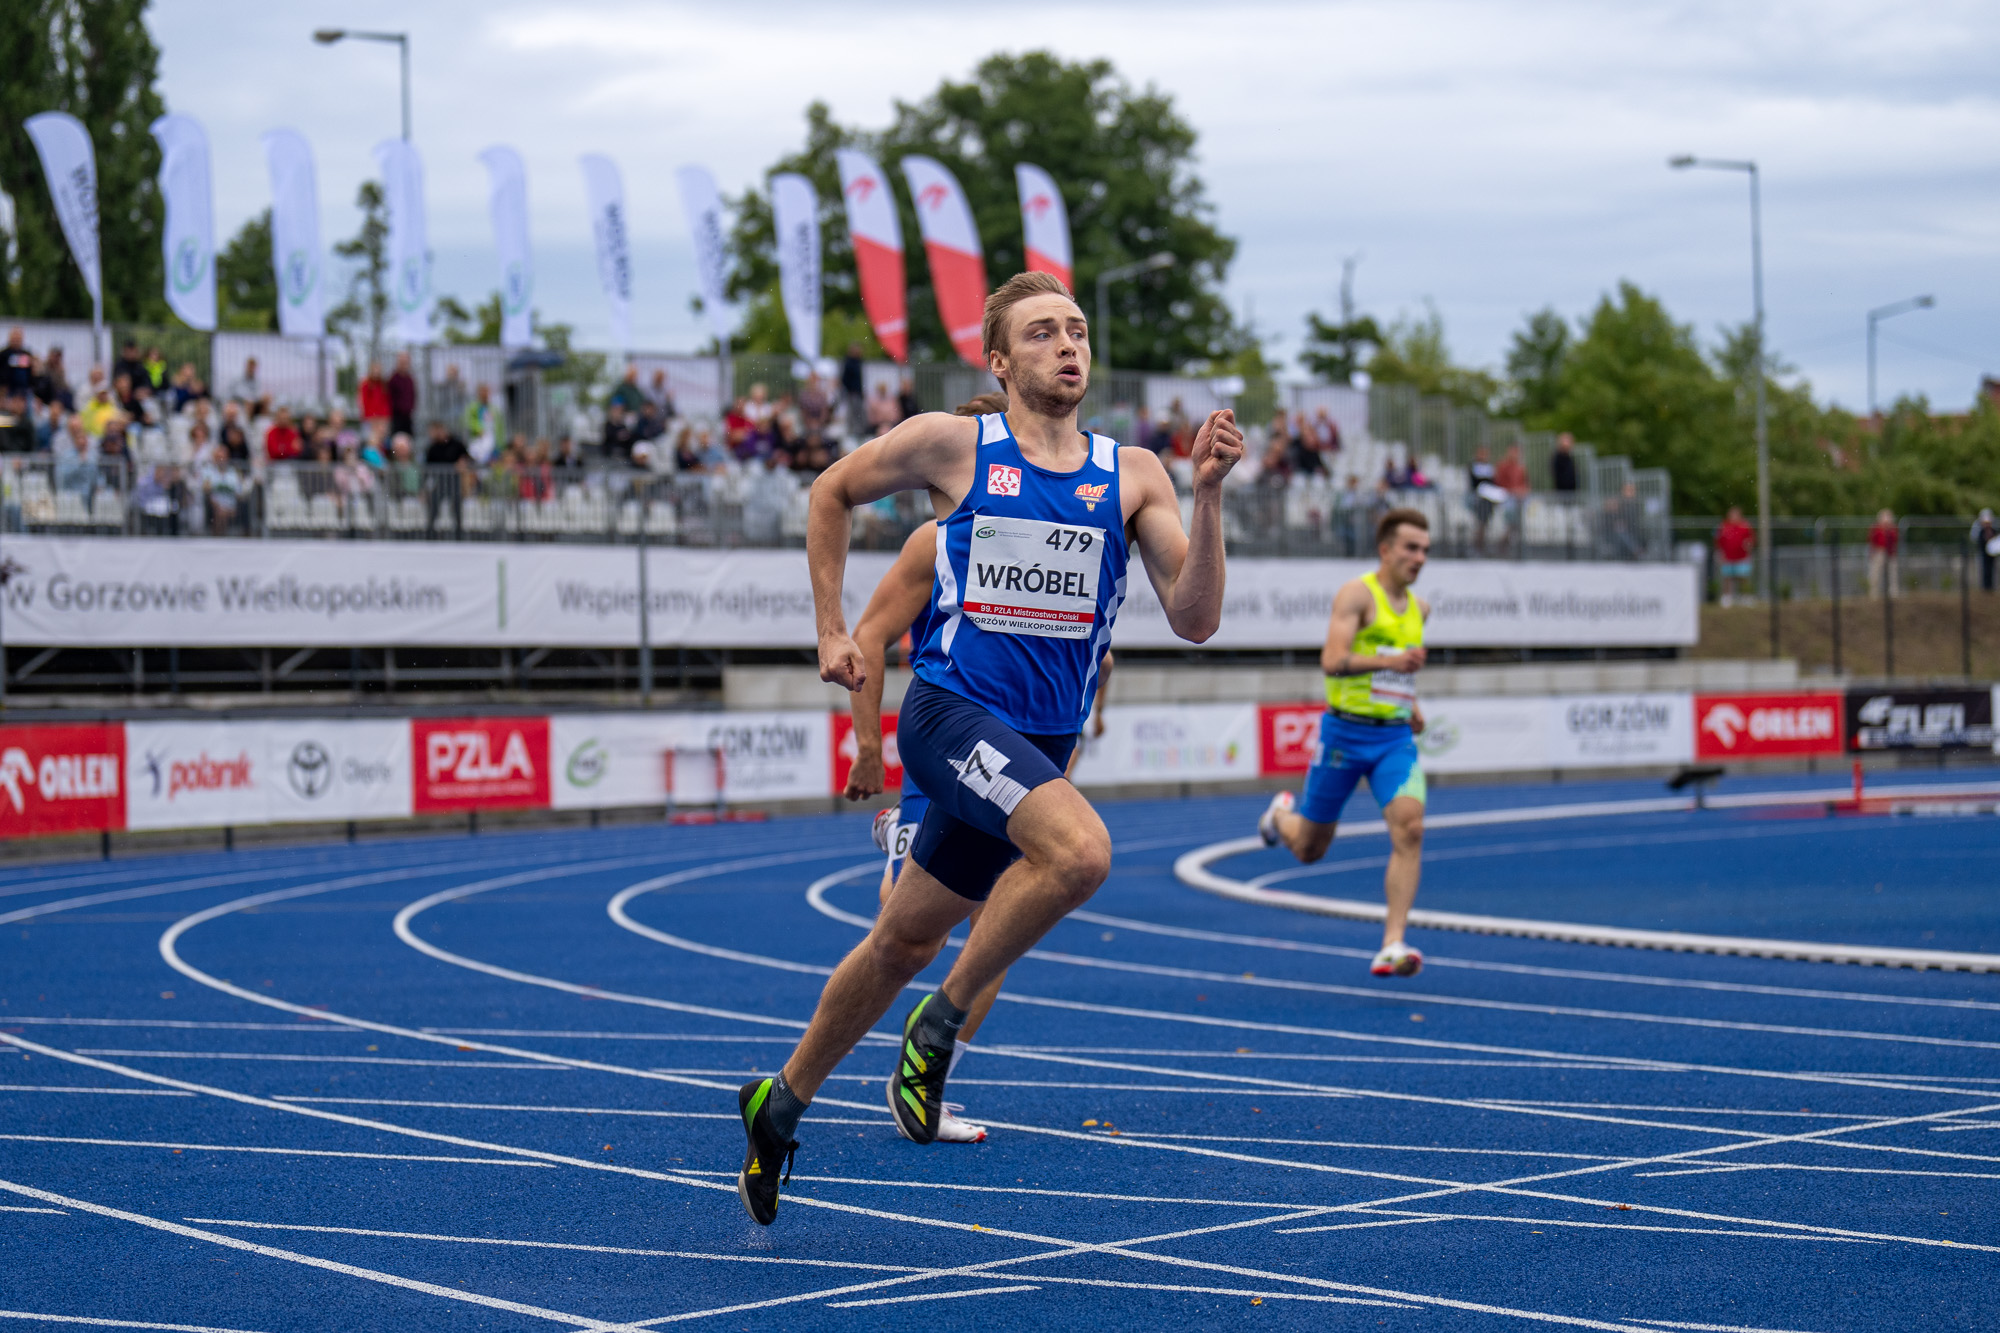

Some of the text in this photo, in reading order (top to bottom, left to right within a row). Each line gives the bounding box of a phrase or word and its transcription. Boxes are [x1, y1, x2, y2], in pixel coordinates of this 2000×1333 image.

[1075, 484, 1109, 498] AWF
[1046, 529, 1093, 553] 479
[47, 574, 207, 612] Gorzowie
[217, 575, 446, 621] Wielkopolskim
[976, 563, 1090, 598] WRÓBEL
[557, 579, 698, 622] Wspieamy
[981, 605, 1079, 621] 99. PZLA Mistrzostwa Polski
[1009, 620, 1067, 632] WIELKOPOLSKI
[1067, 626, 1087, 634] 2023
[1274, 711, 1320, 754] PZ
[1749, 706, 1834, 741] ORLEN
[427, 732, 535, 782] PZLA
[964, 749, 993, 783] 7
[39, 755, 119, 800] ORLEN
[895, 827, 909, 856] 6
